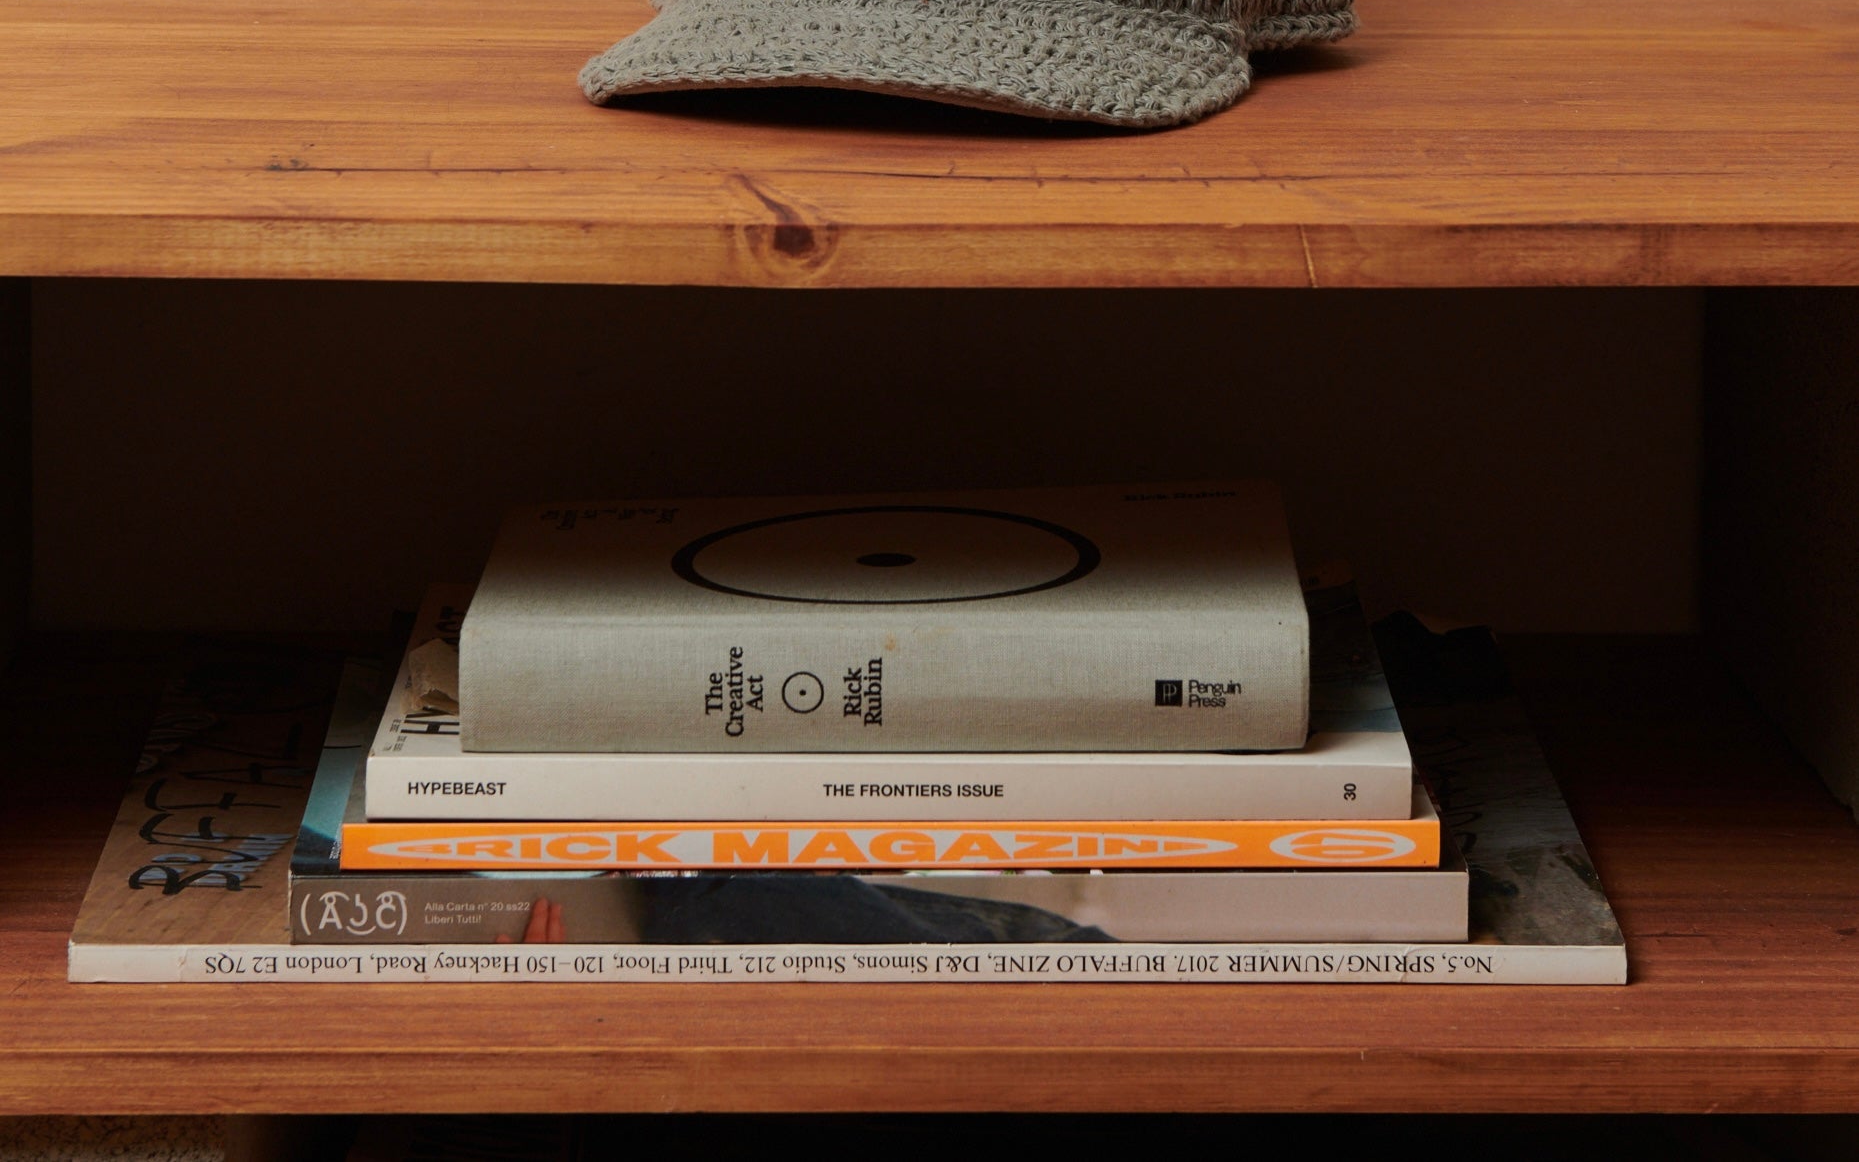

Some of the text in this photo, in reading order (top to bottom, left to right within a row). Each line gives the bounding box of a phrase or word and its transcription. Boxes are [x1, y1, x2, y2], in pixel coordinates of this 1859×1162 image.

[705, 672, 723, 715] The
[725, 646, 744, 737] Creative
[746, 674, 763, 713] Act
[843, 667, 862, 717] Rick
[864, 657, 882, 727] Rubin
[1189, 679, 1242, 697] Penguin
[1189, 694, 1226, 707] Press
[408, 782, 507, 795] HYPEBEAST
[823, 784, 1004, 797] THE FRONTIERS ISSUE
[1343, 783, 1357, 801] 30
[397, 832, 681, 863] BRICK
[424, 902, 444, 911] Alla
[446, 902, 475, 911] Carta
[490, 902, 504, 911] 20
[204, 952, 247, 975] 7QS
[252, 956, 278, 974] E2
[285, 956, 363, 975] London
[369, 953, 430, 975] Road,
[433, 951, 520, 975] Hackney
[612, 953, 671, 975] Floor,
[678, 956, 733, 975] Third
[738, 953, 776, 974] 212,
[782, 955, 846, 975] Studio
[852, 953, 928, 974] Simons,
[934, 955, 980, 974] D&J
[987, 953, 1051, 973] ZINE,
[1056, 955, 1167, 973] BUFFALO
[1173, 955, 1220, 973] 2017.
[1227, 953, 1435, 975] SPRING/SUMMER
[1441, 953, 1494, 974] No.5,
